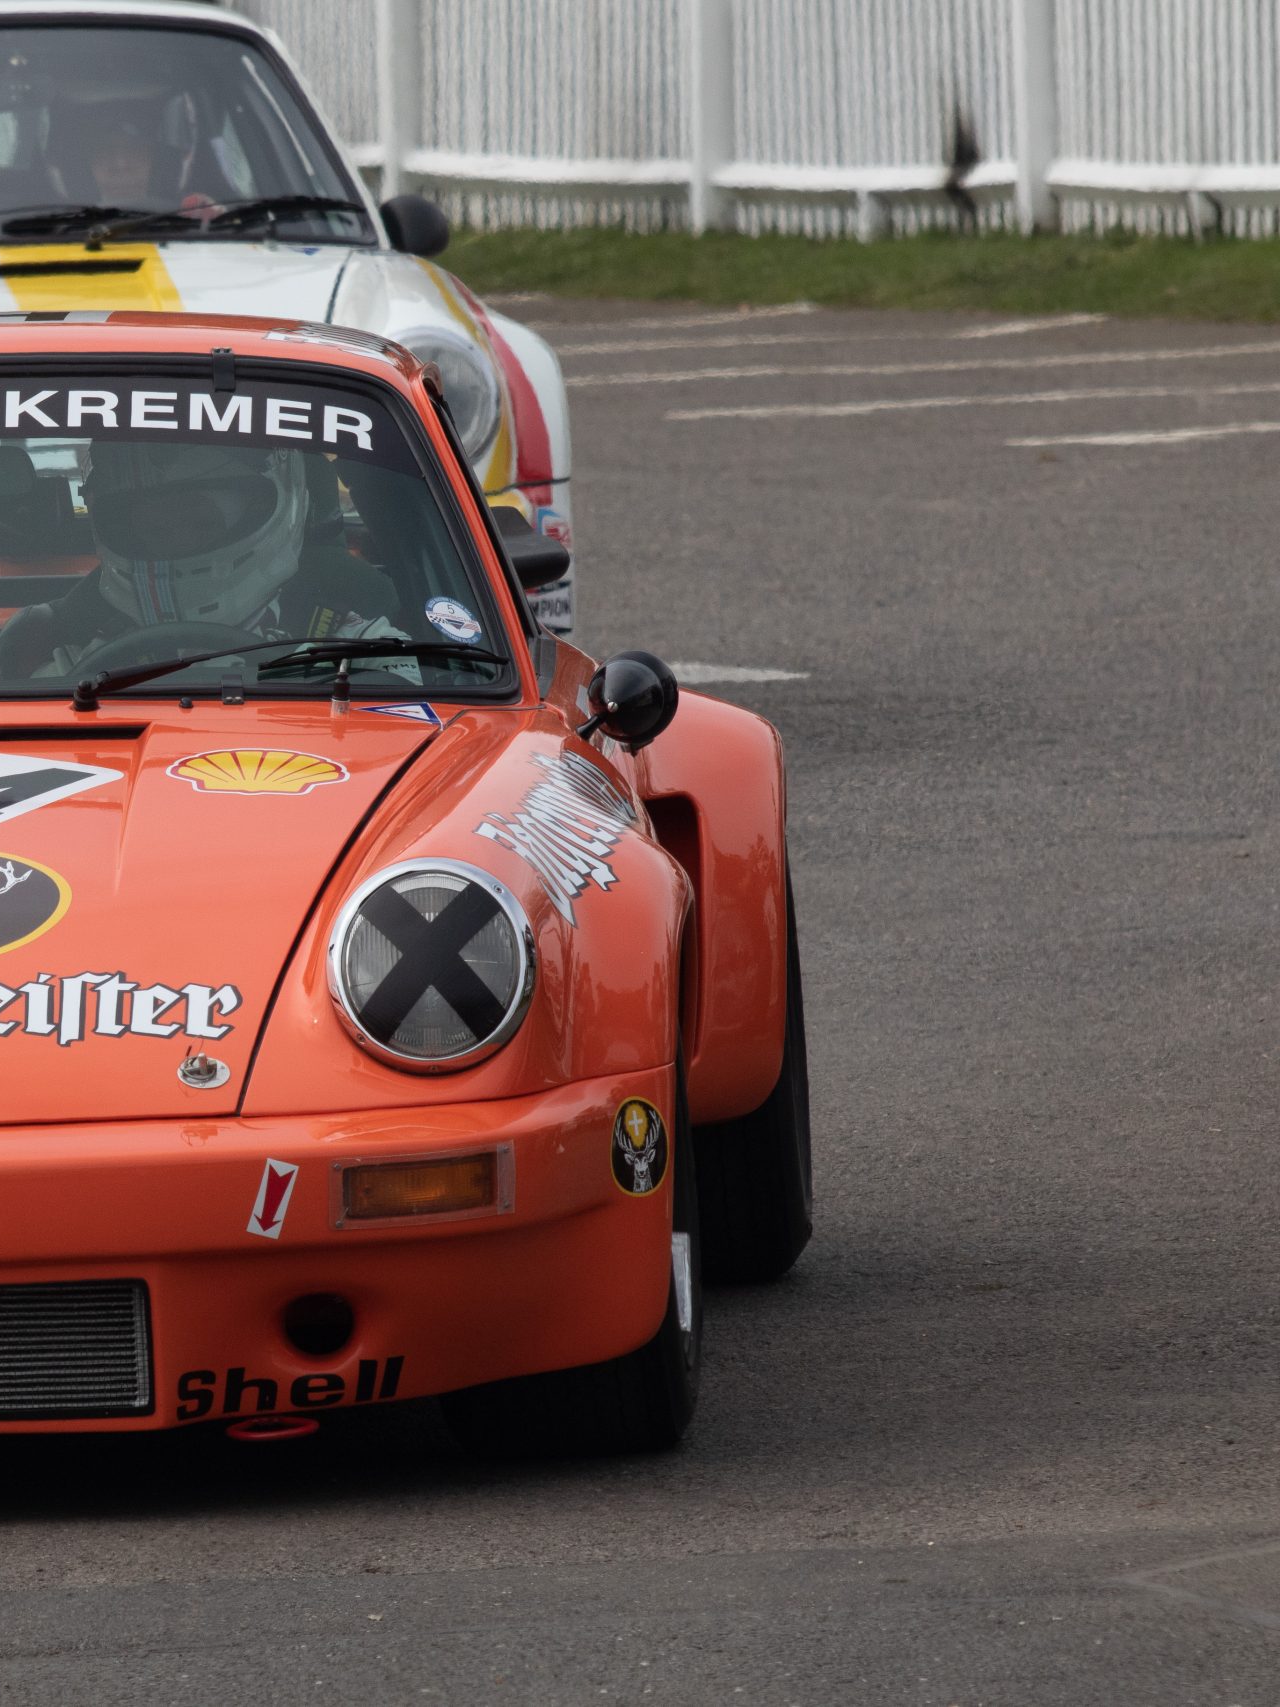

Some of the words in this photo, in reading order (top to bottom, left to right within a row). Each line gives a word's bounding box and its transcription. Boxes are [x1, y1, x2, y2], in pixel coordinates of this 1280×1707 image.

[5, 390, 375, 450] KREMER
[447, 604, 455, 614] 5
[177, 1355, 403, 1421] Shell
